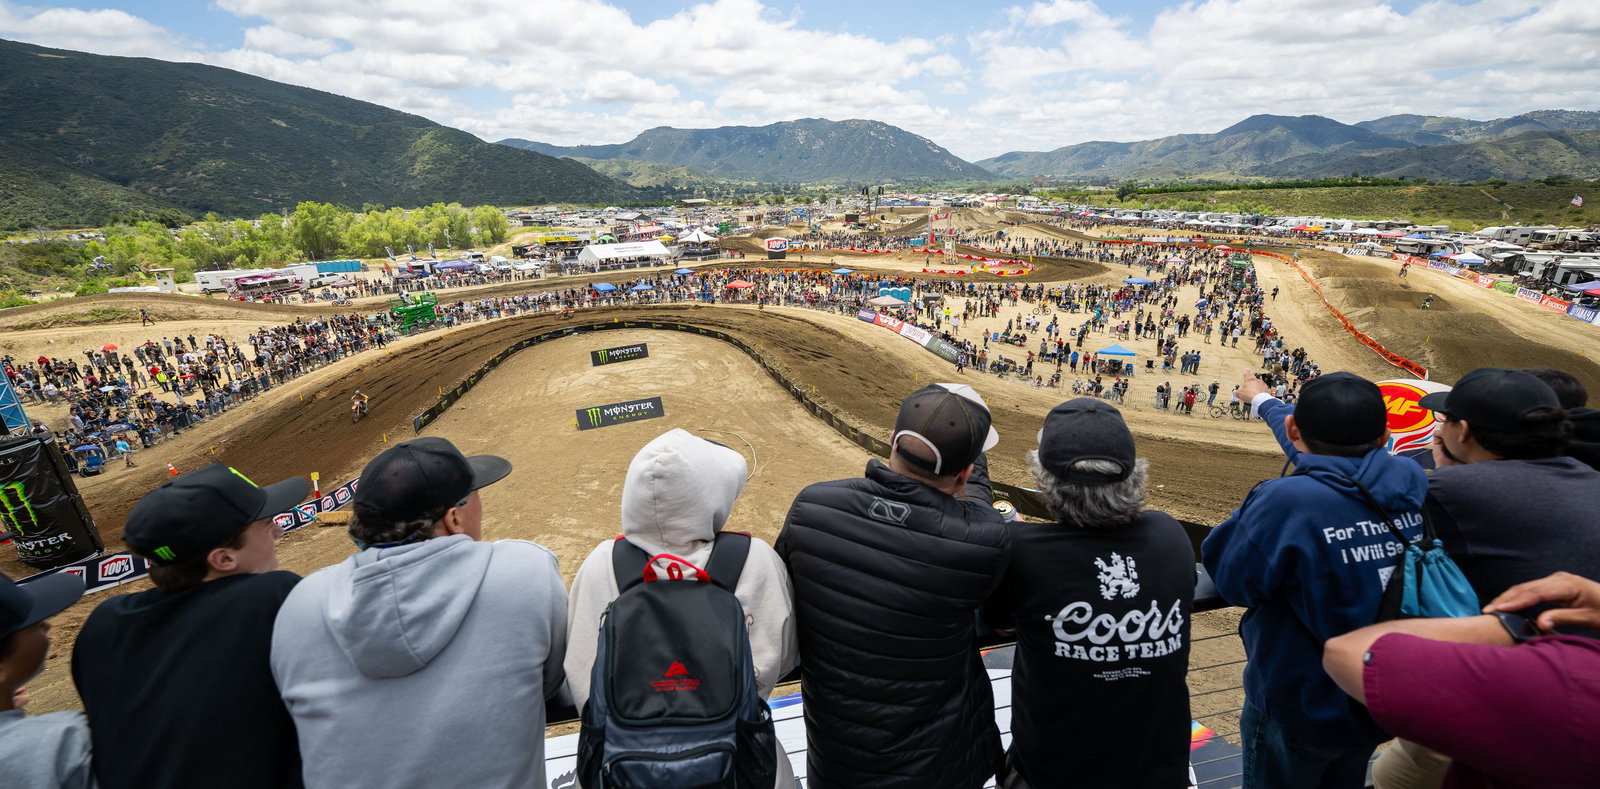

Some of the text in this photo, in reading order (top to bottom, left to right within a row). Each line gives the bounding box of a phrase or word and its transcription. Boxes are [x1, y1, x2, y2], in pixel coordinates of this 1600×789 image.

[769, 240, 786, 249] 100%
[1347, 248, 1368, 256] THOR
[1519, 288, 1541, 299] PARTS
[1547, 300, 1568, 311] HONDA
[609, 346, 642, 357] MONSTER
[604, 401, 654, 416] MONSTER
[1383, 395, 1423, 416] MF
[613, 411, 648, 421] ENERGY
[1323, 527, 1355, 544] For
[1356, 518, 1404, 536] Thoe
[1341, 549, 1349, 564] I
[1350, 543, 1385, 563] Will
[104, 559, 129, 577] 100%
[1045, 599, 1184, 645] Coors
[1054, 633, 1182, 662] RACE TEAM
